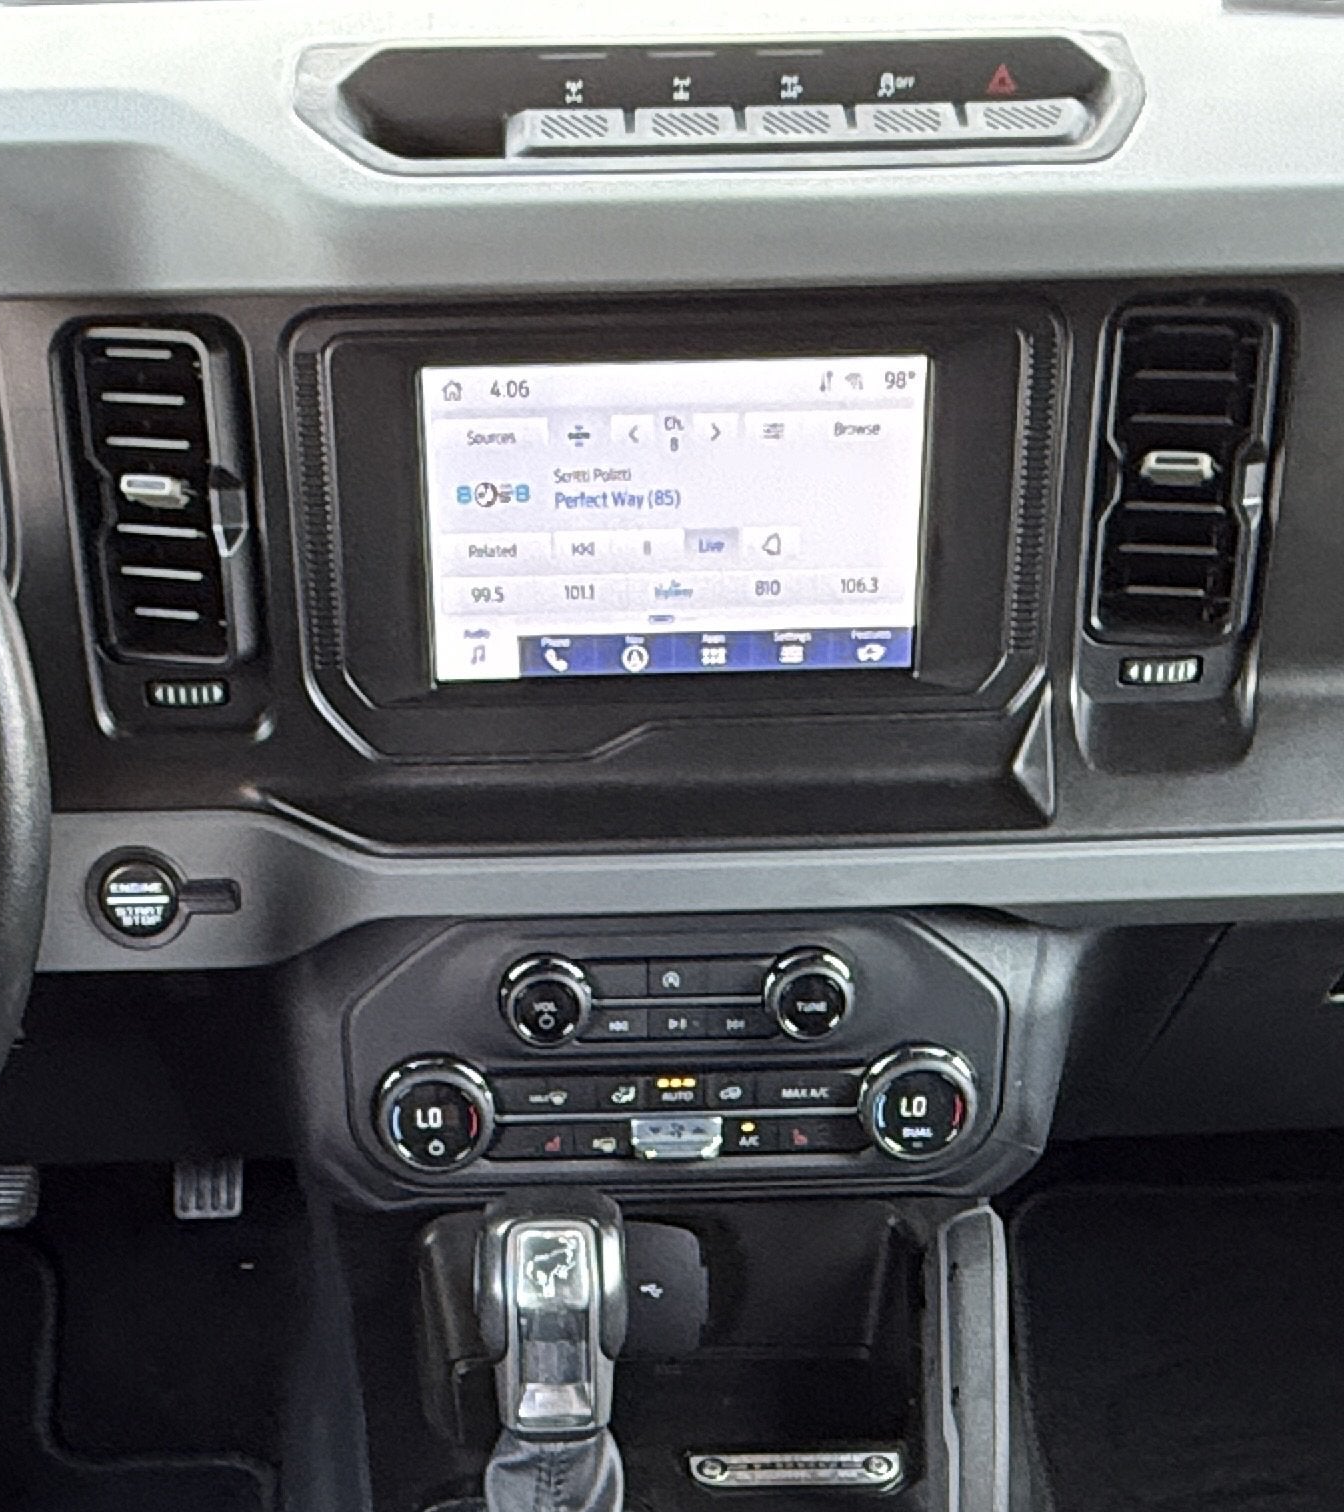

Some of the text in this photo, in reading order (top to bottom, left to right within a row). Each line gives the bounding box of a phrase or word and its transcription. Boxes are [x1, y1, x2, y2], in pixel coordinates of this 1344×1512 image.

[884, 370, 916, 389] 98°
[834, 421, 881, 437] Browse
[467, 430, 516, 446] Sources
[555, 490, 681, 509] Perfect Way (85)
[468, 544, 517, 558] Related
[755, 580, 782, 596] 810
[840, 577, 879, 594] 106.3
[471, 586, 505, 604] 99.5
[661, 1091, 694, 1102] AUTO
[780, 1087, 831, 1099] MAX A/C
[900, 1096, 927, 1118] LO
